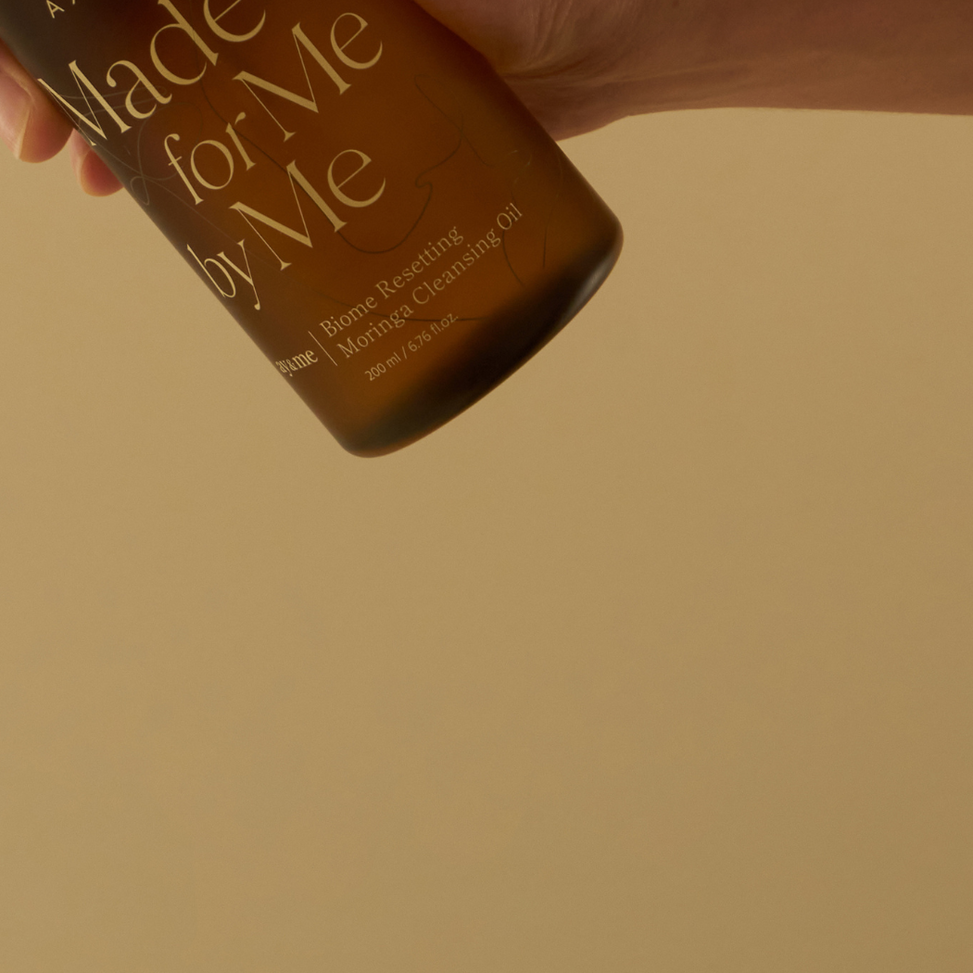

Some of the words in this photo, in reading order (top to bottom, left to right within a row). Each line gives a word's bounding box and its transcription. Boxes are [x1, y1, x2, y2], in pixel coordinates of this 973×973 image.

[165, 111, 256, 205] for
[232, 12, 383, 142] Me
[186, 238, 261, 311] by
[229, 149, 386, 272] Me
[319, 296, 378, 338] Biome
[375, 227, 464, 299] Resetting
[336, 304, 414, 359] Moringa
[412, 228, 501, 305] Cleansing
[496, 202, 523, 231] Oil
[364, 362, 387, 381] 200
[388, 352, 402, 369] ml
[401, 345, 409, 360] /
[407, 332, 432, 353] 6.76
